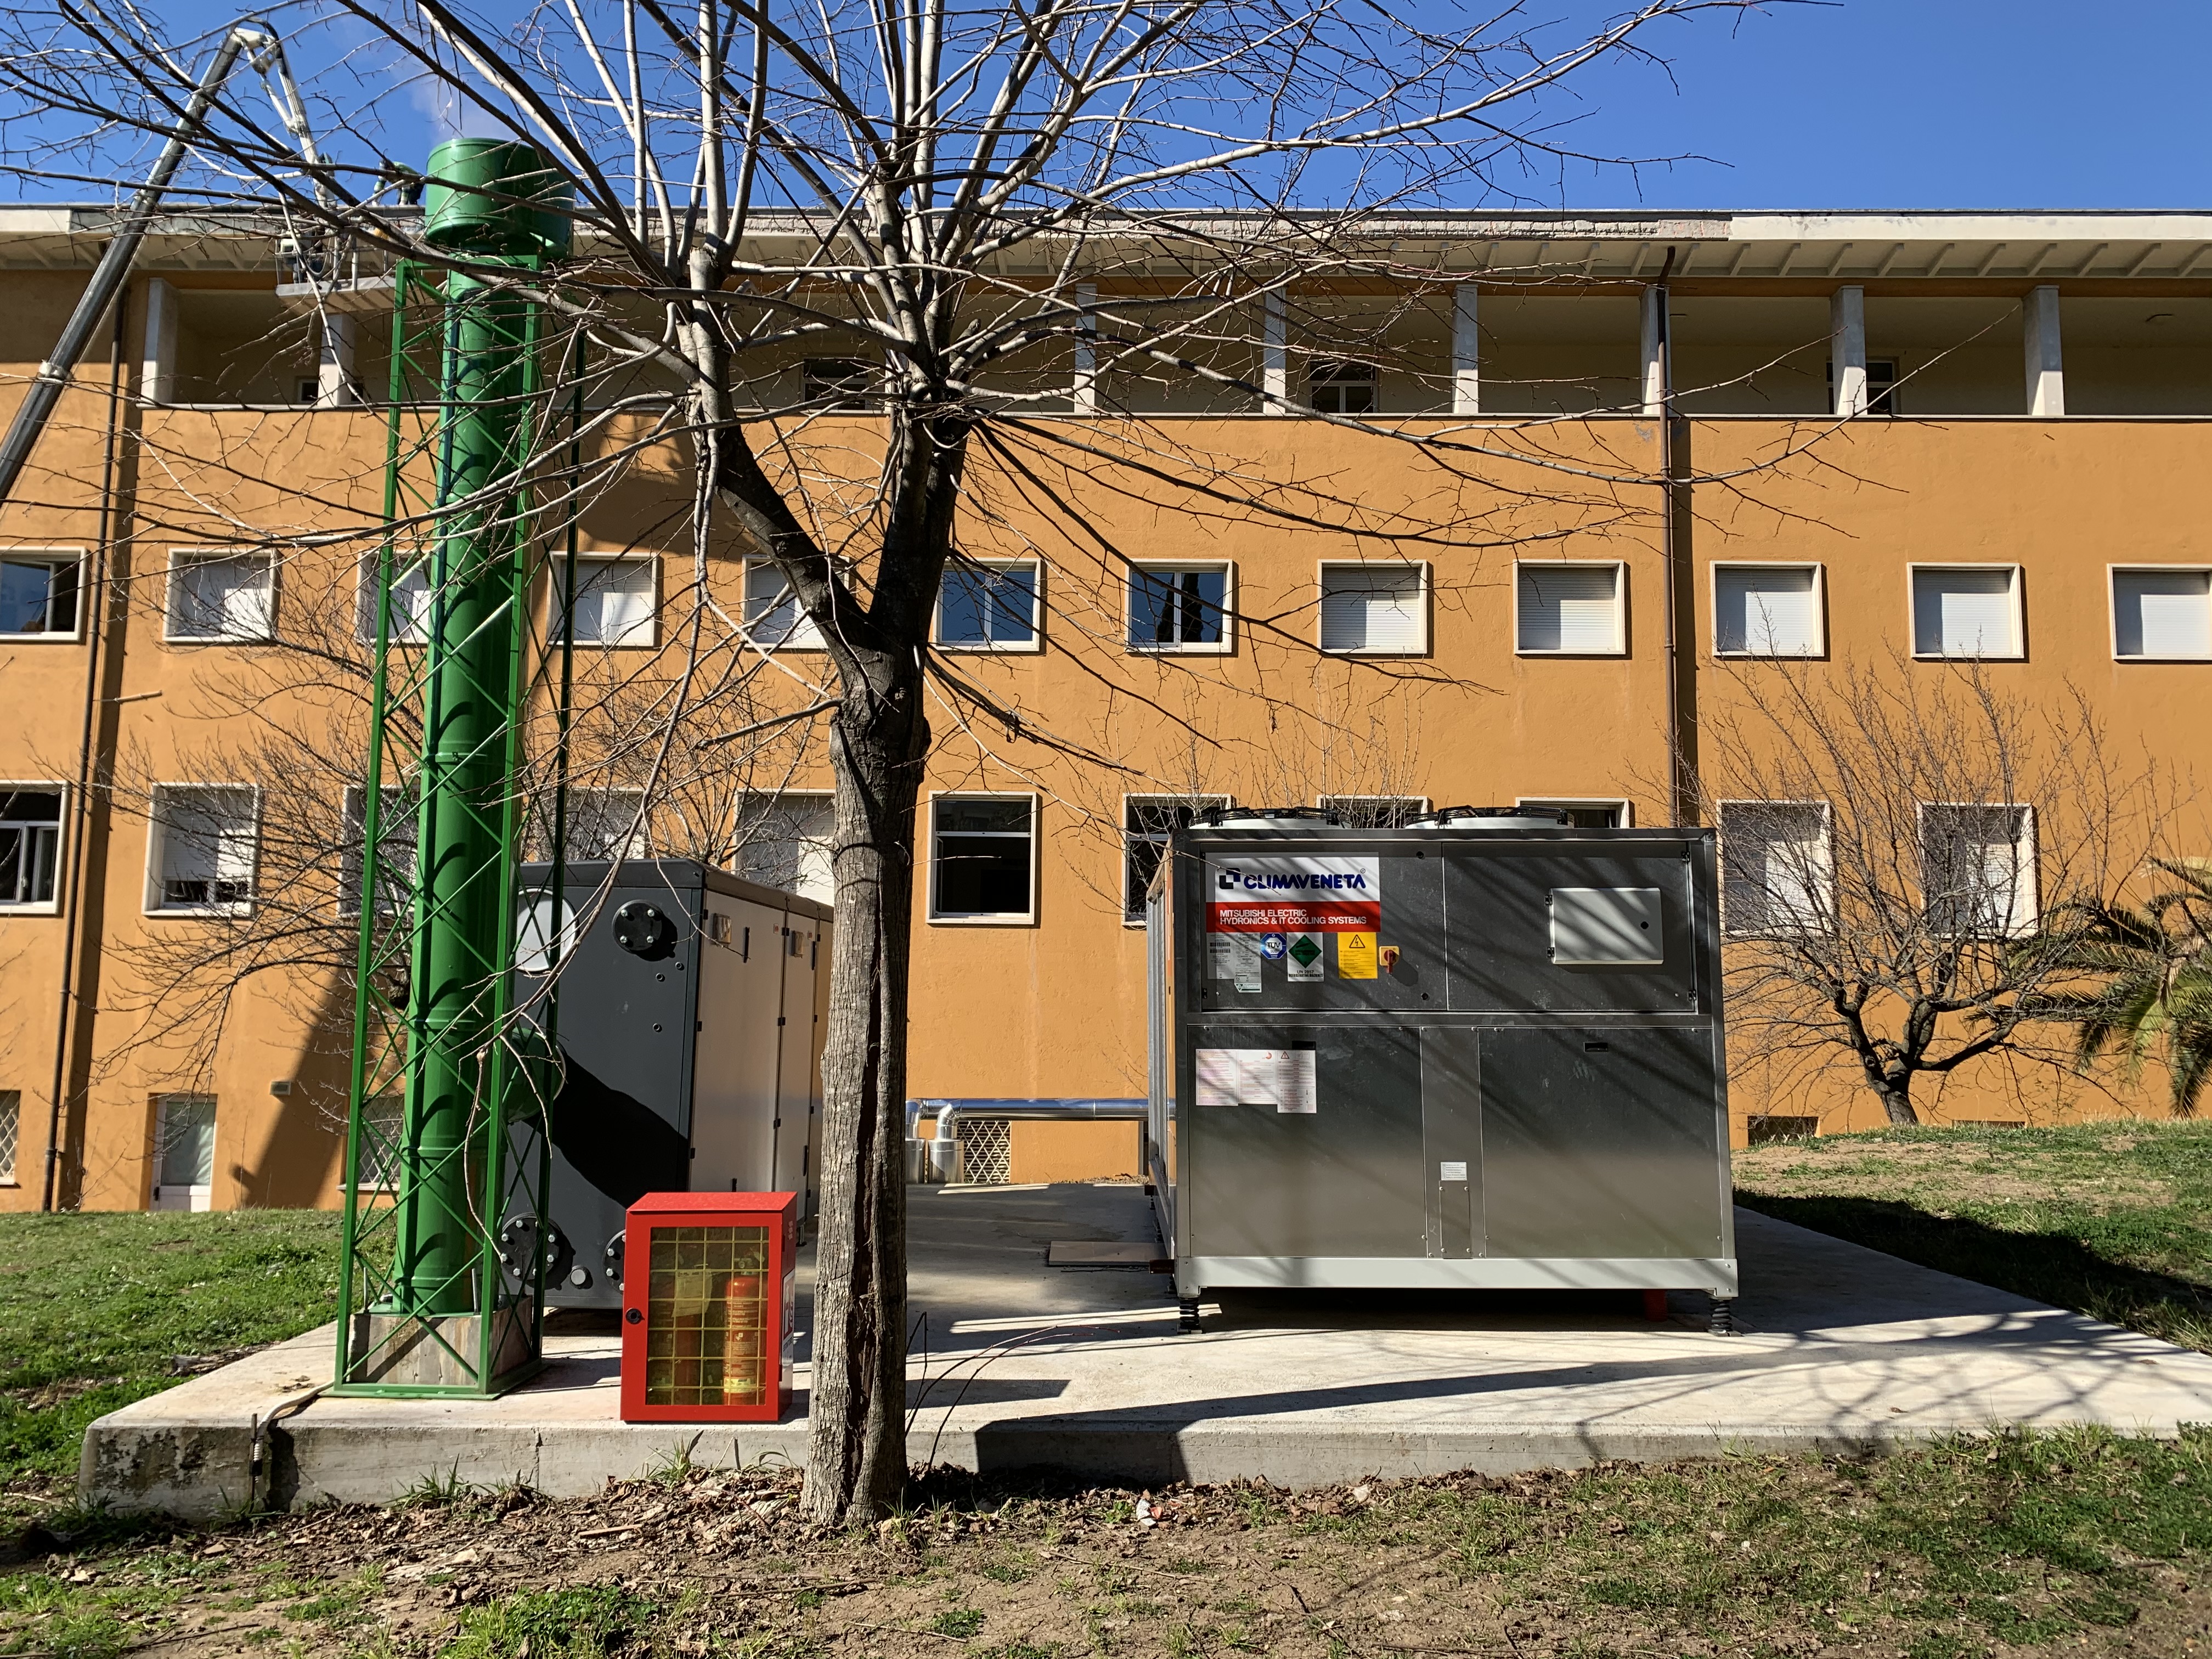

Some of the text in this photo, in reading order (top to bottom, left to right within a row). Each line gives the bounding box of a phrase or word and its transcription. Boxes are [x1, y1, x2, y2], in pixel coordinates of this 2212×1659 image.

[1244, 874, 1366, 889] CLIMAVENETA
[1220, 917, 1269, 925] HYDRONICS
[1287, 916, 1327, 924] COOLING
[1328, 916, 1367, 924] SYSTEMS
